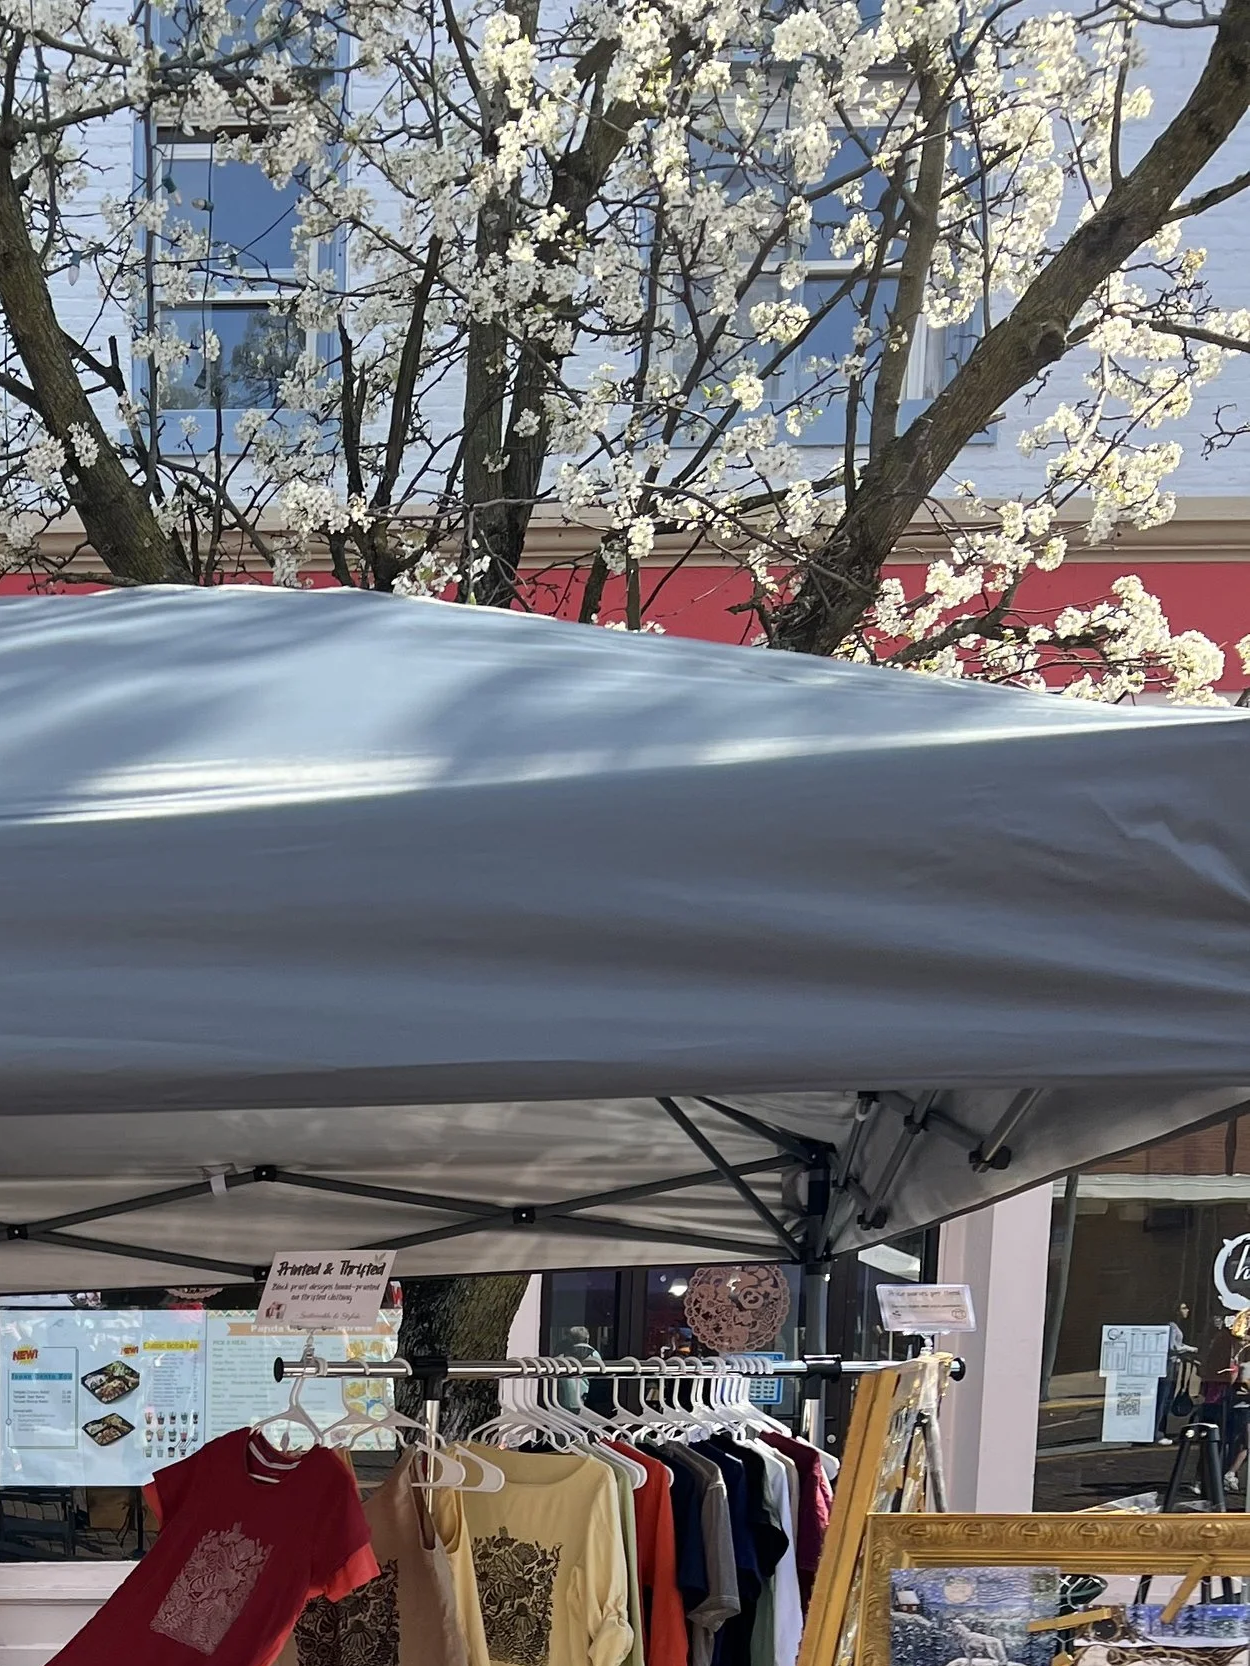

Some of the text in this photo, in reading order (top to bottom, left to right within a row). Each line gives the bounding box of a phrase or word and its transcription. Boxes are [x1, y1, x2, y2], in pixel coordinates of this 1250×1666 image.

[277, 1260, 386, 1278] Printed & Thrifted
